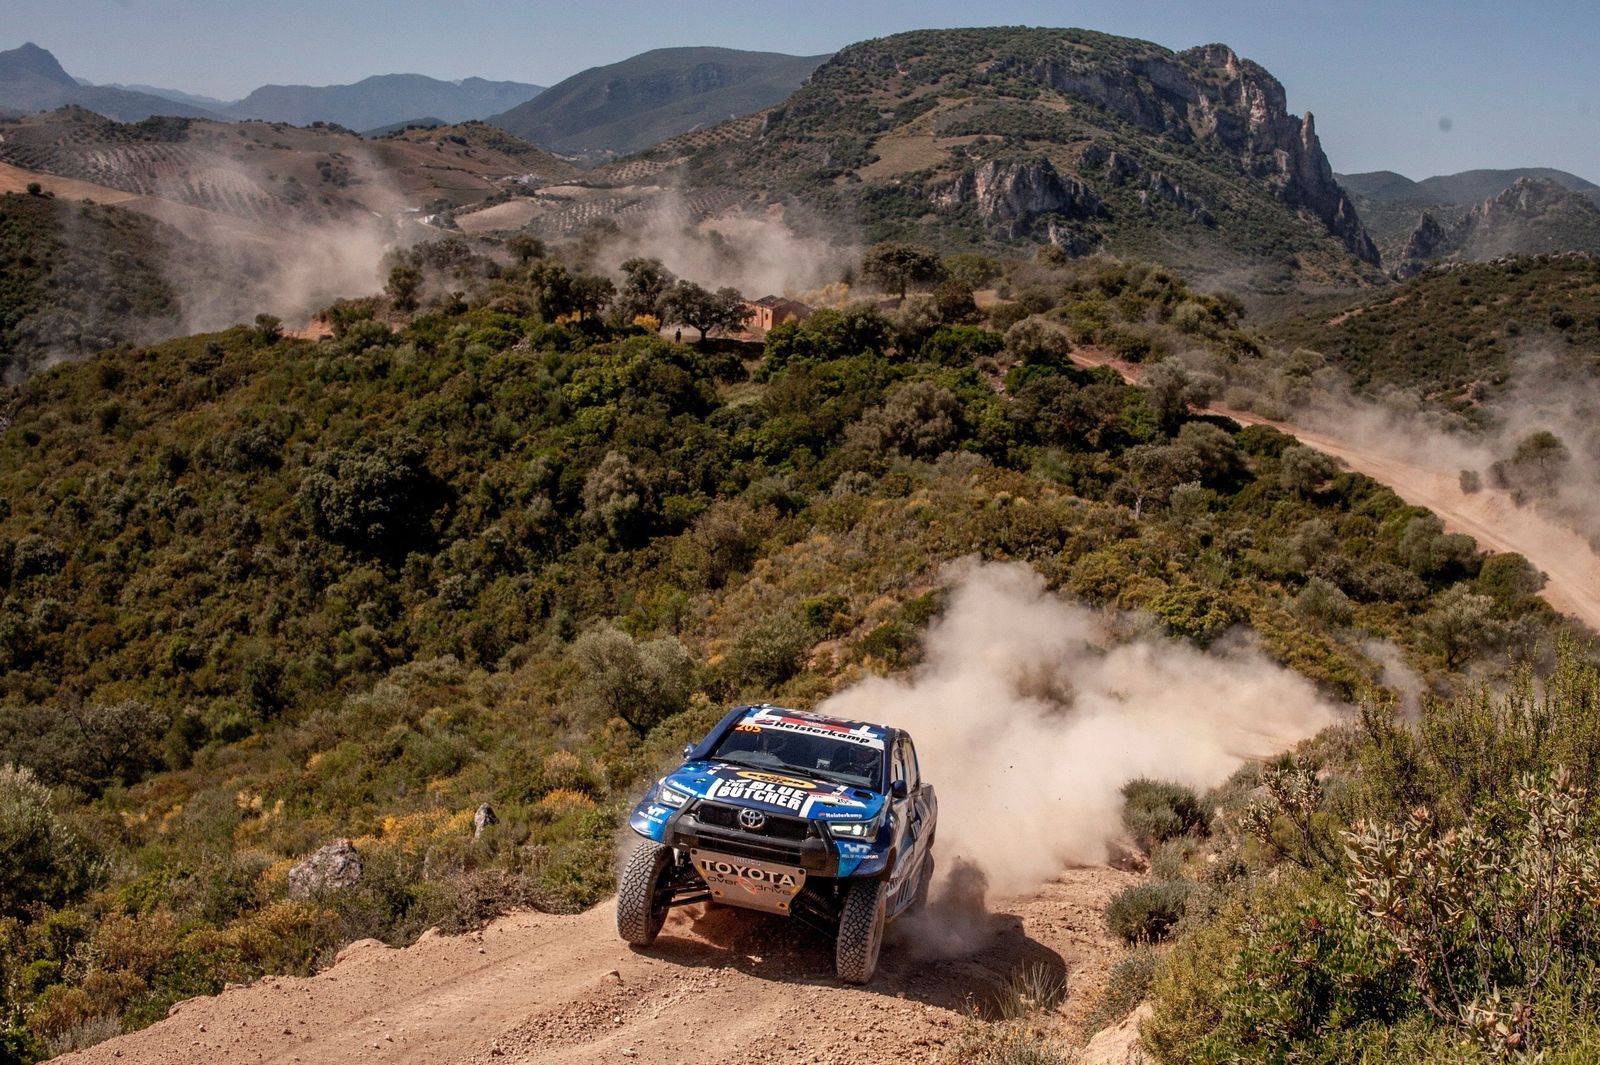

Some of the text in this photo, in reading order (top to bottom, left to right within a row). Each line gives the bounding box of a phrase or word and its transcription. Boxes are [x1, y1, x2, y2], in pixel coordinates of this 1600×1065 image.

[736, 724, 762, 733] 205
[773, 721, 870, 744] Heisterkamp
[717, 786, 804, 811] BUTCHER
[725, 780, 807, 800] THE BLUE
[701, 859, 795, 887] TOYOTA
